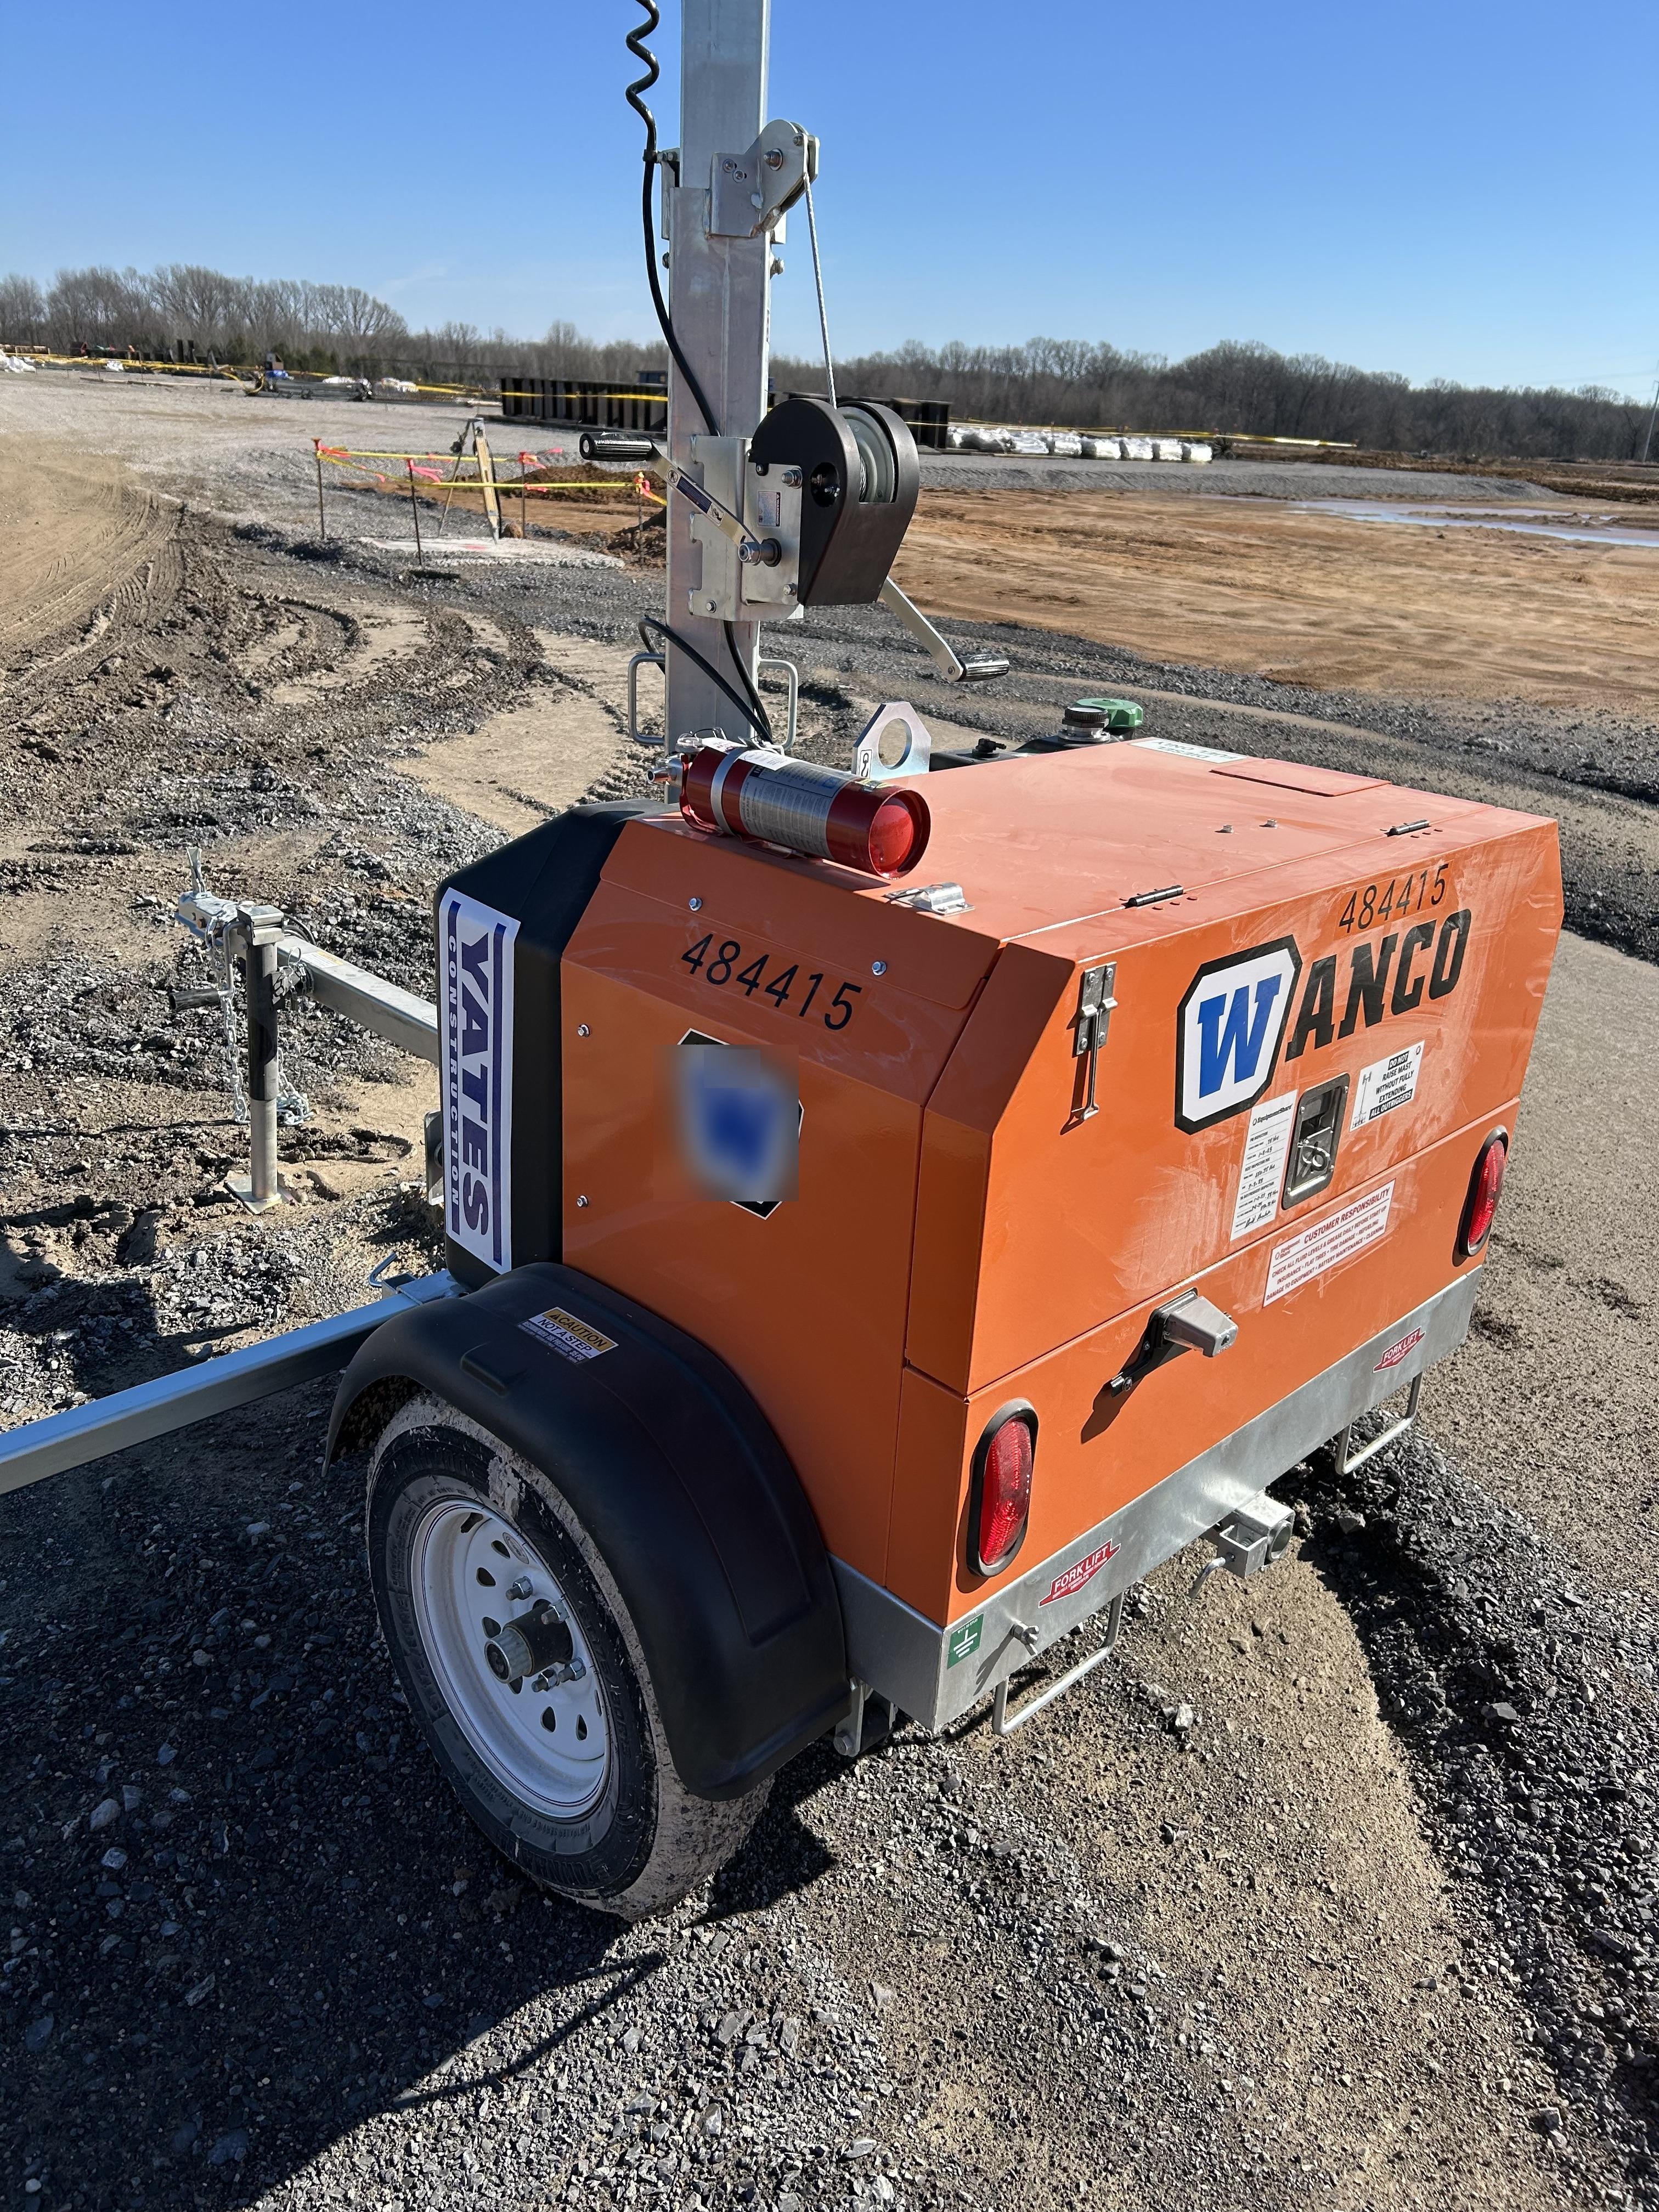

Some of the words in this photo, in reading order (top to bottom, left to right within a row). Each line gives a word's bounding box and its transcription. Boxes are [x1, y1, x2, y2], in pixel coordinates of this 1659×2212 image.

[1150, 741, 1194, 751] ONLY
[1157, 746, 1209, 759] DIESEL
[1199, 750, 1237, 759] FUEL
[1339, 864, 1449, 933] 484415
[681, 933, 862, 1030] 484415
[1197, 909, 1471, 1099] WANCO
[448, 935, 459, 1206] CONSTRUCTION
[1382, 1068, 1397, 1081] RAISE
[1397, 1061, 1412, 1073] MAST
[1389, 1058, 1397, 1068] DO
[1397, 1052, 1408, 1063] NOT
[461, 932, 489, 1235] YATES
[1375, 1077, 1398, 1094] WITHOUT
[1399, 1070, 1414, 1082] FULLY
[1379, 1084, 1407, 1102] EXTENDING
[1370, 1106, 1381, 1117] ALL
[1380, 1091, 1412, 1111] OUTRIGGERS
[1304, 1217, 1340, 1244] CUSTOMER
[1340, 1188, 1390, 1222] RESPONSIBILITY
[1272, 1265, 1286, 1278] CHECK
[1295, 1252, 1307, 1263] FLUID
[1308, 1243, 1323, 1256] LEVELS
[1327, 1232, 1342, 1245] GREASE
[1342, 1224, 1353, 1235] DAILY
[1354, 1216, 1368, 1228] BEFORE
[1369, 1209, 1380, 1219] START
[1277, 1266, 1301, 1284] INSURANCE
[1305, 1257, 1314, 1267] FLAT
[1339, 1233, 1355, 1246] DAMAGE
[1266, 1285, 1284, 1300] DAMAGE
[1290, 1267, 1314, 1285] EQUIPMENT
[1318, 1255, 1335, 1268] BATTERY
[1335, 1238, 1363, 1257] MAINTENANCE
[538, 1319, 561, 1331] NOT
[565, 1335, 592, 1352] STEP
[558, 1317, 607, 1347] CAUTION
[1384, 1341, 1403, 1362] FORK
[1403, 1331, 1419, 1348] LIFT
[1054, 1565, 1085, 1593] FORK
[1085, 1545, 1108, 1573] LIFT
